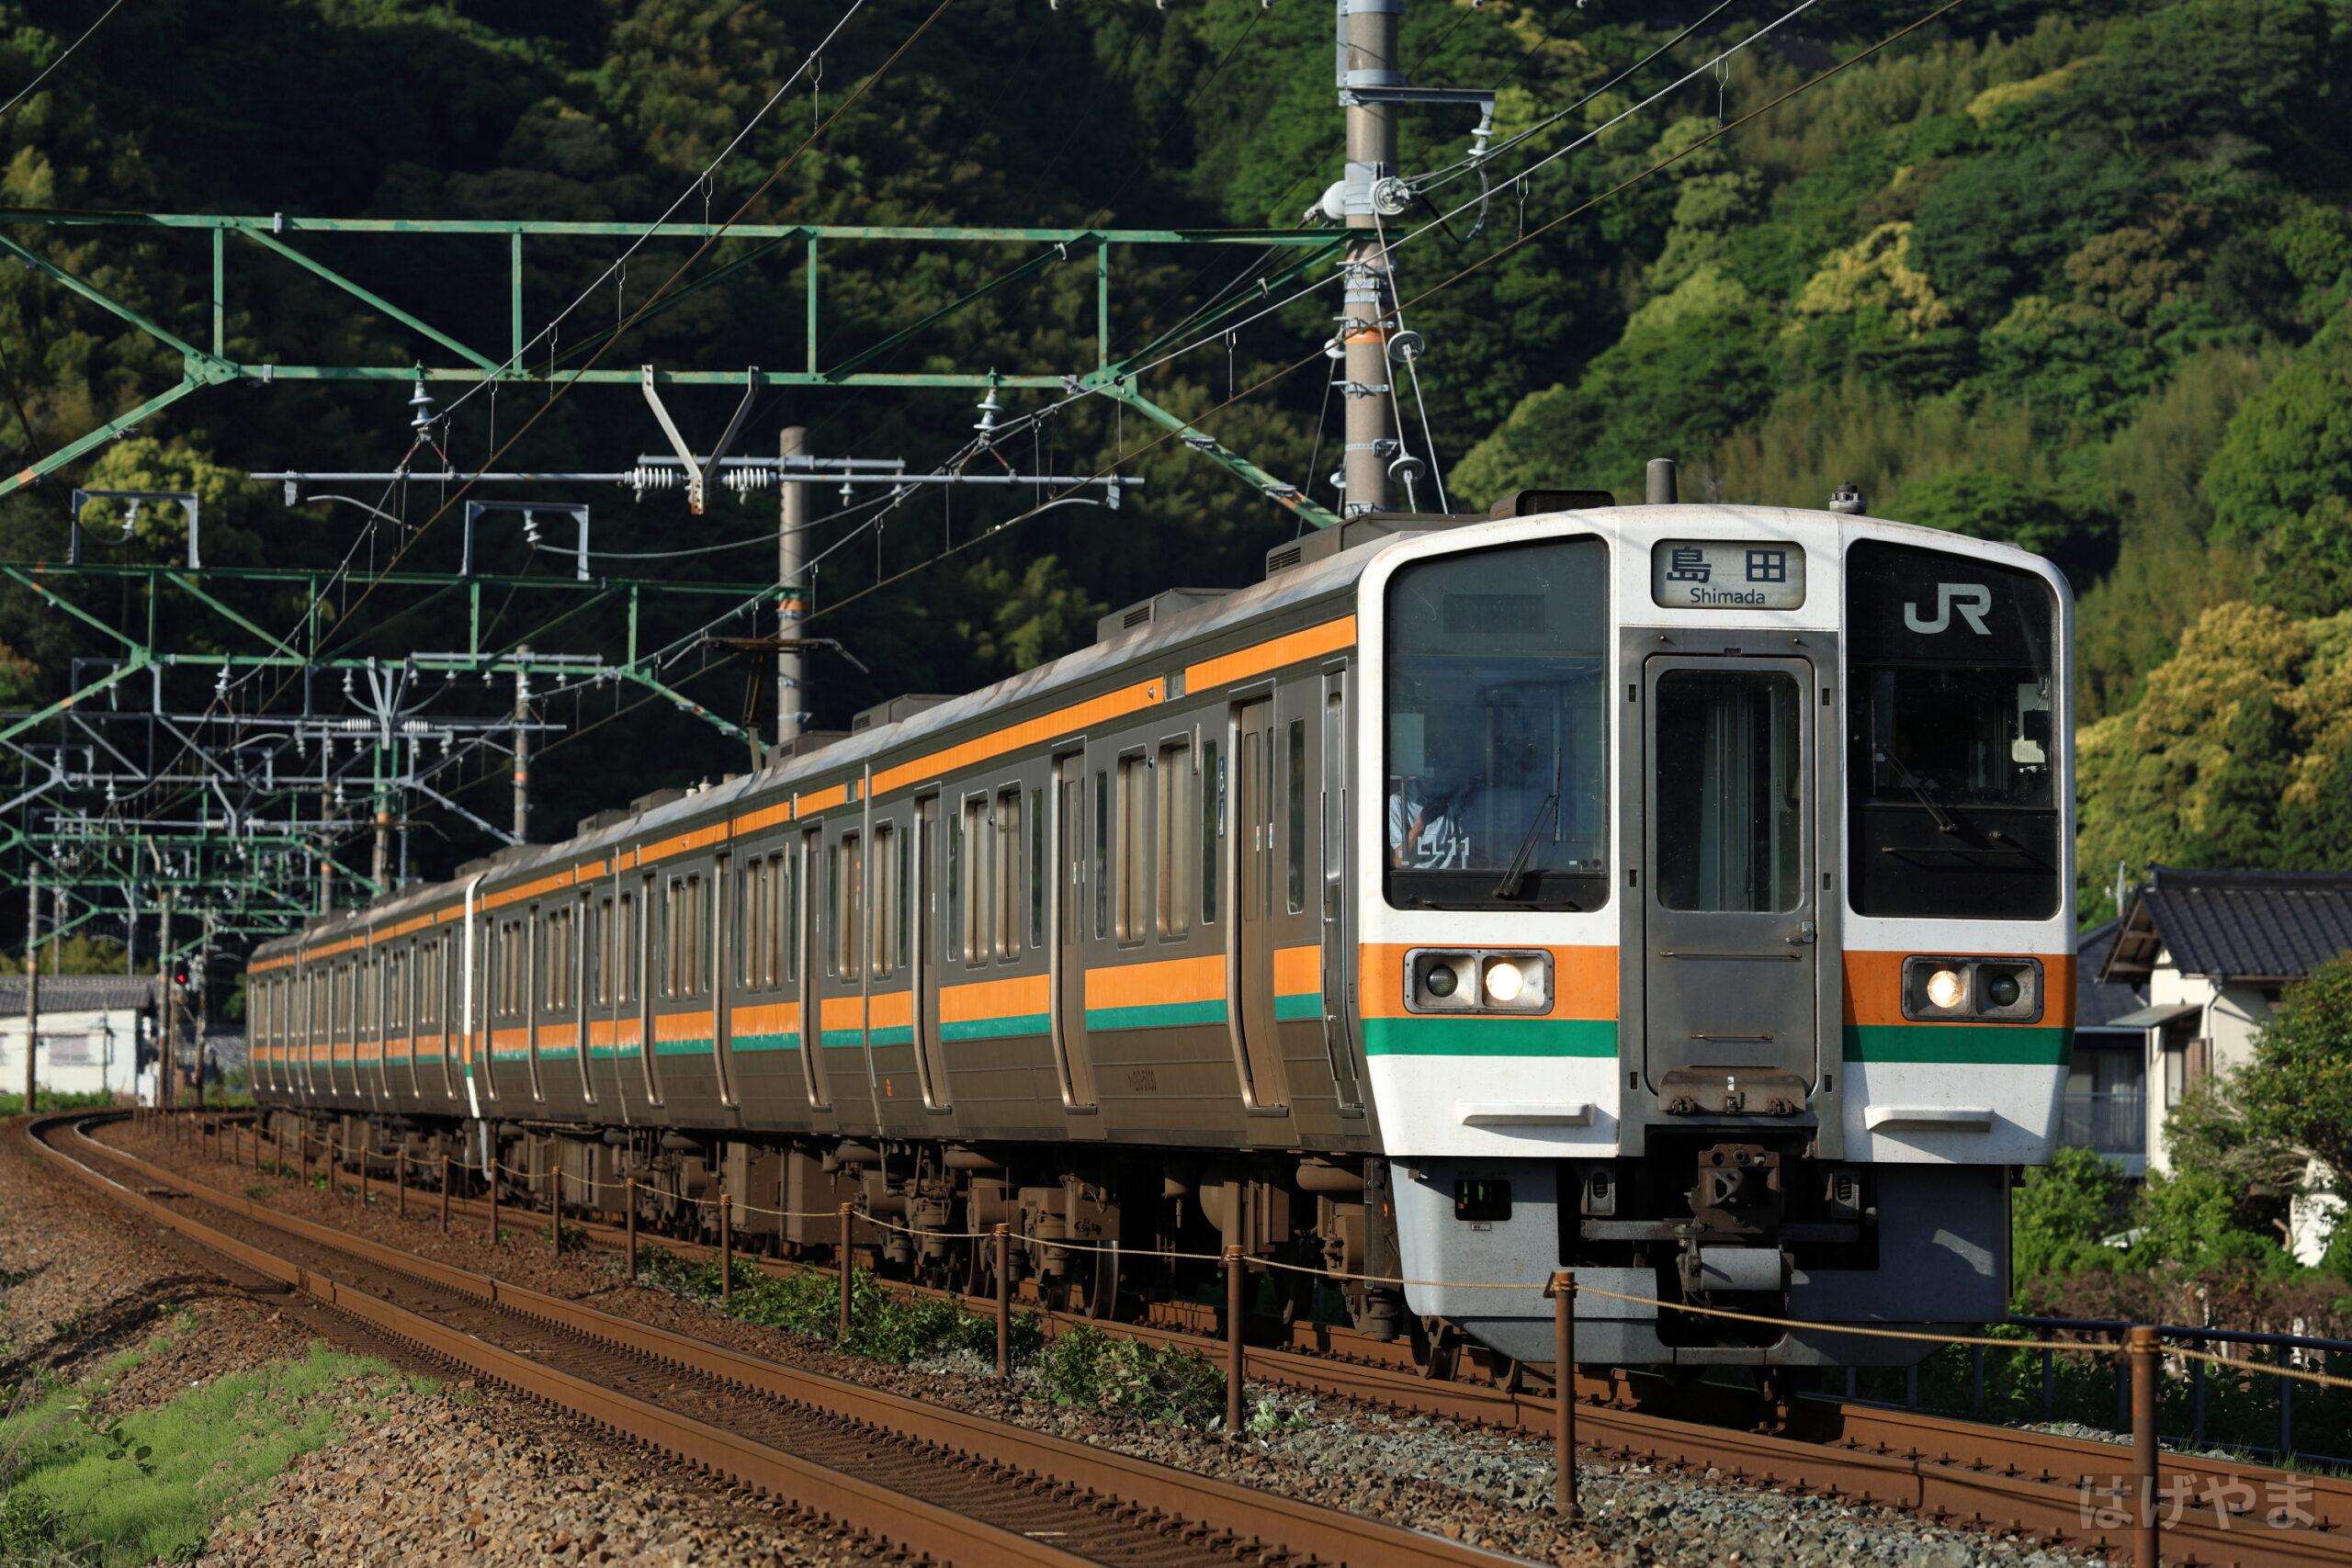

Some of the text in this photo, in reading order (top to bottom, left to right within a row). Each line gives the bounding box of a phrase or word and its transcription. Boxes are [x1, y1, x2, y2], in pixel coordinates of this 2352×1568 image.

[1667, 546, 1785, 583] 島田
[1690, 587, 1766, 604] Shimada
[1904, 582, 1992, 635] JR
[1417, 836, 1470, 856] LL11
